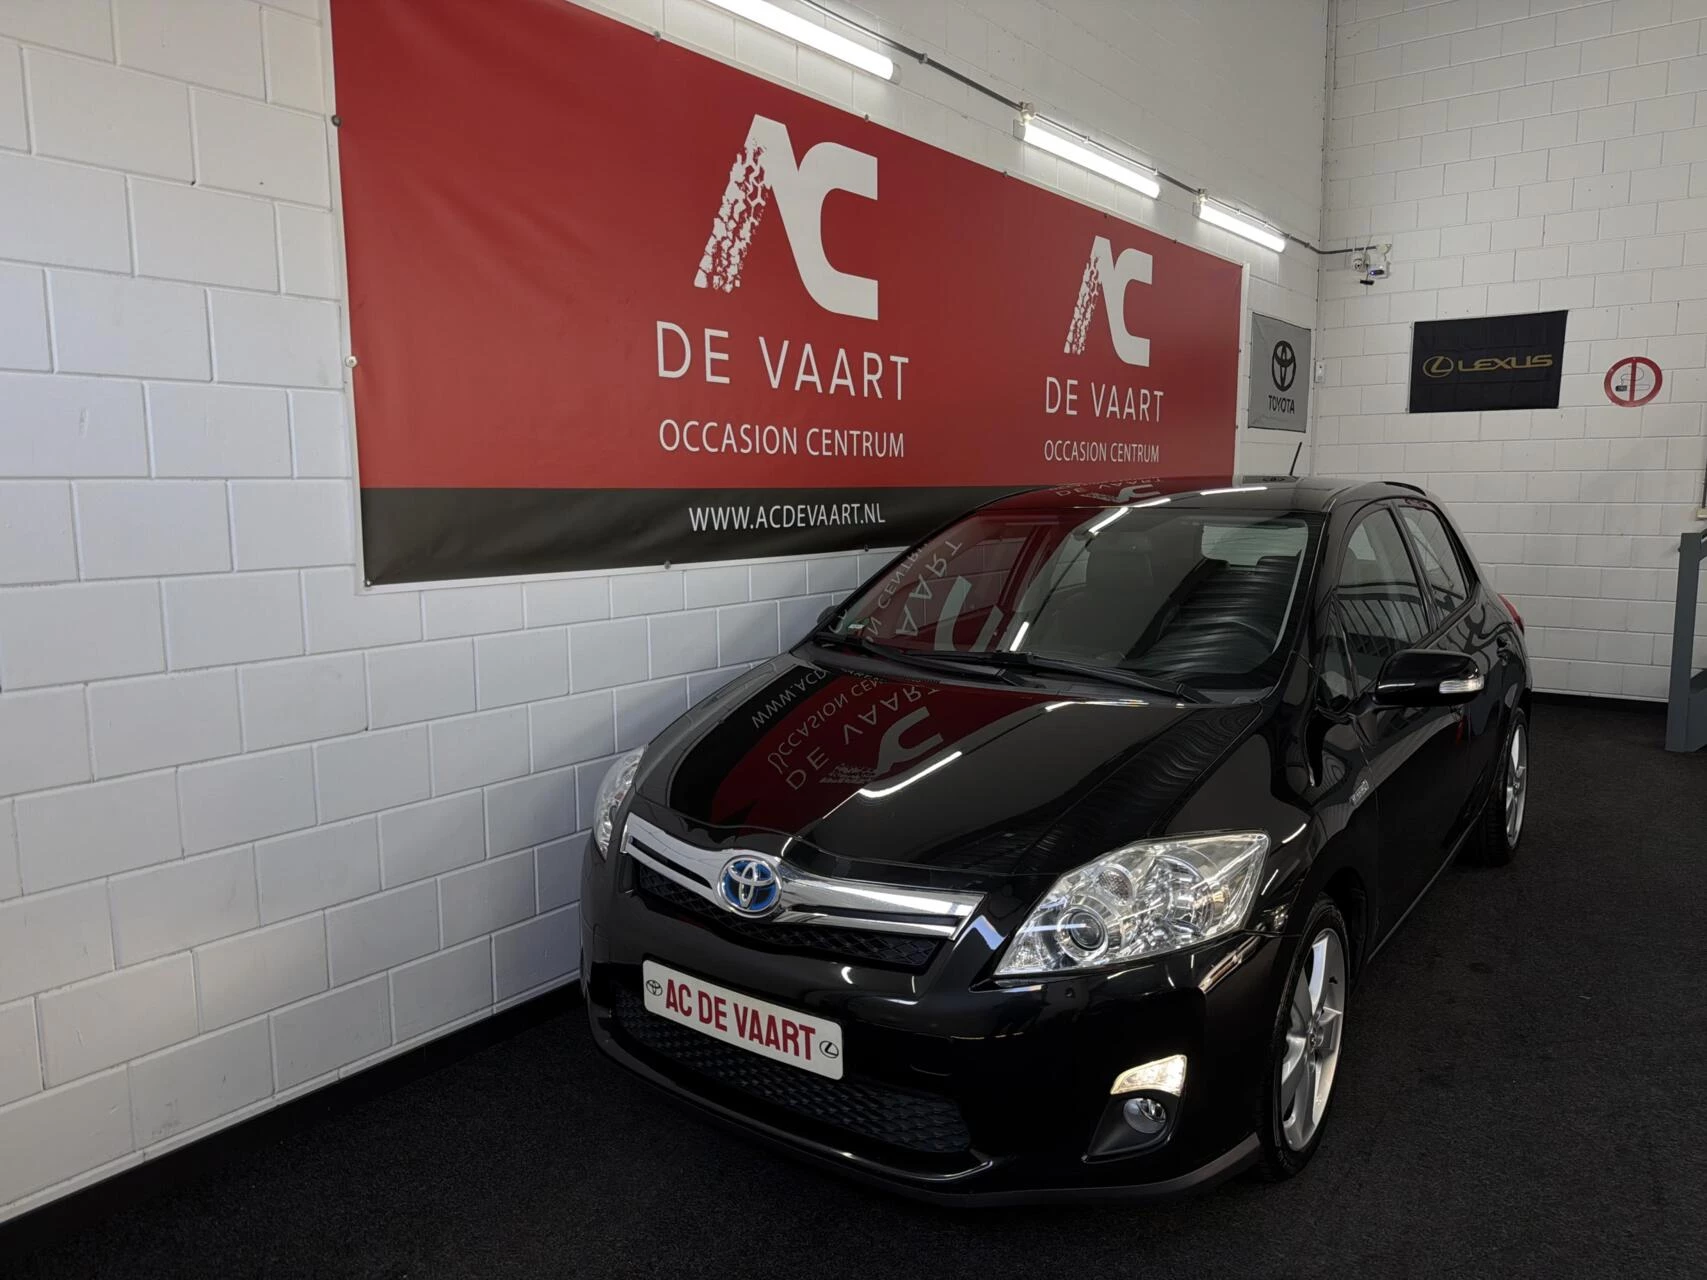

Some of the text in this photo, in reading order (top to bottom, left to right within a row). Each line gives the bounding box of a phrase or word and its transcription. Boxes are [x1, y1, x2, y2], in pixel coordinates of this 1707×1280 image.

[694, 114, 878, 321] AC
[1063, 235, 1153, 367] AC
[656, 320, 909, 401] DE VAART
[1457, 354, 1553, 373] LEXUS
[1045, 376, 1164, 423] DE VAART
[1268, 395, 1295, 414] TOYOTA
[658, 419, 905, 458] OCCASION CENTRUM
[1044, 439, 1160, 463] OCCASION CENTRUM
[688, 503, 886, 532] WWW.ACDEVAART.NL
[665, 978, 816, 1061] AC DE VAART
